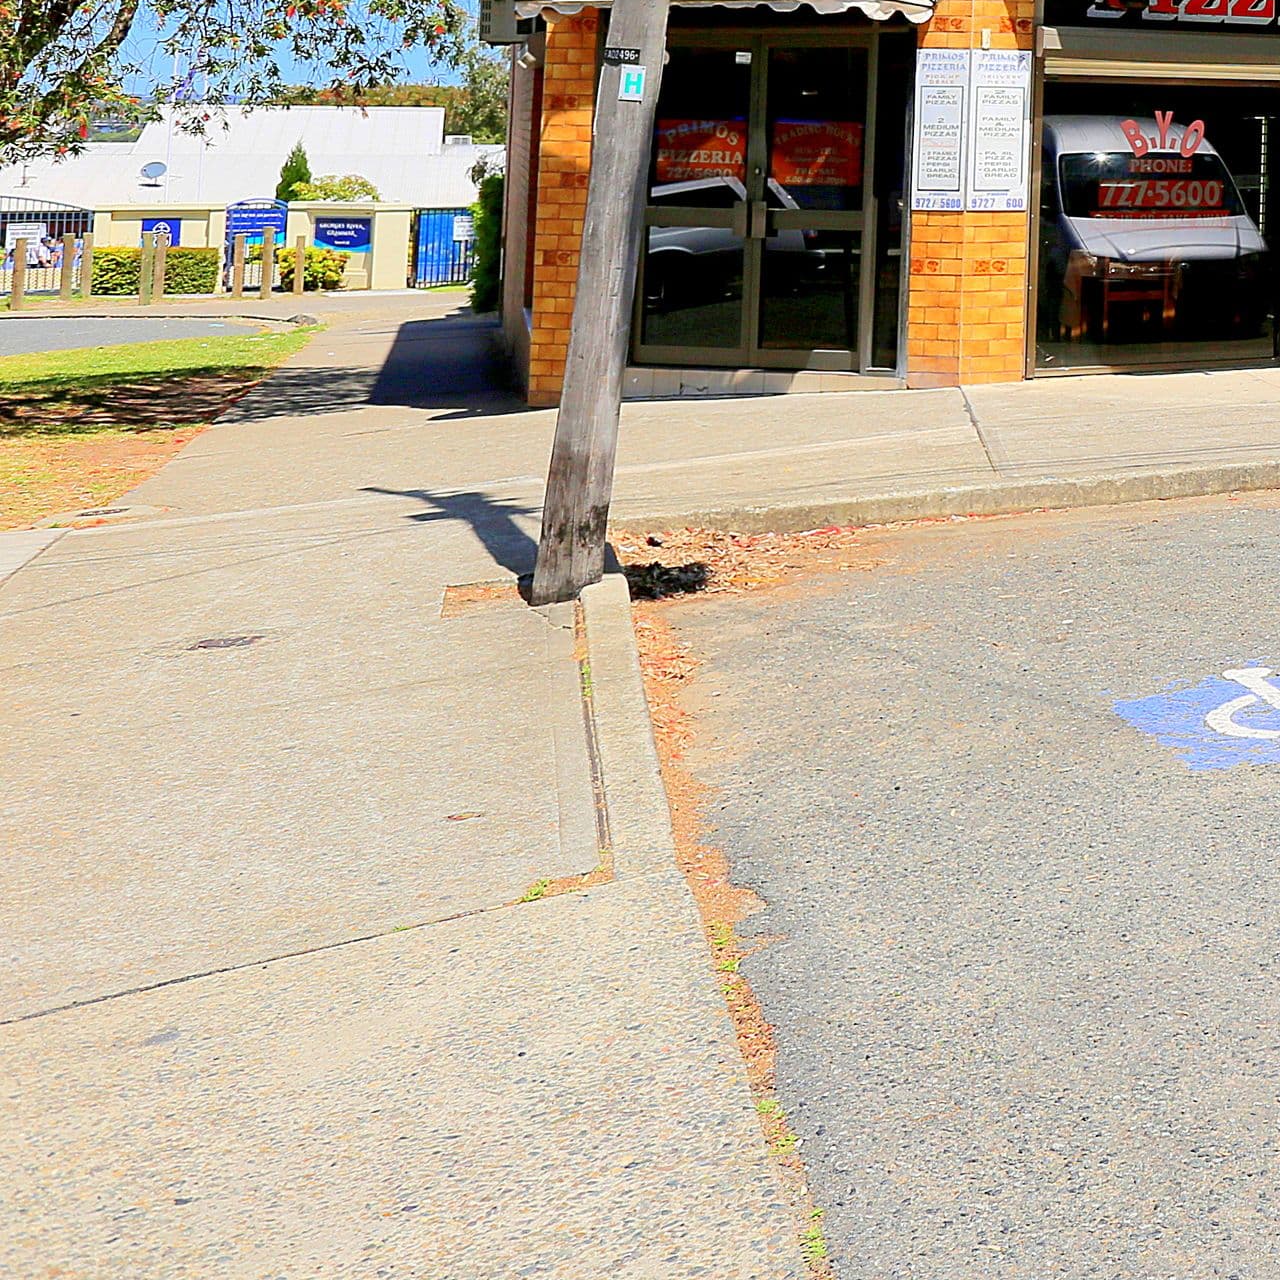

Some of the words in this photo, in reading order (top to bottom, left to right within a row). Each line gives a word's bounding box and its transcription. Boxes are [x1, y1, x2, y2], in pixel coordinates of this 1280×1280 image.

[921, 63, 967, 72] PIZZERIA
[978, 63, 1030, 72] PIZZERIA
[624, 72, 643, 95] H
[657, 149, 744, 165] PIZZERIA
[1129, 159, 1193, 173] PHONE:
